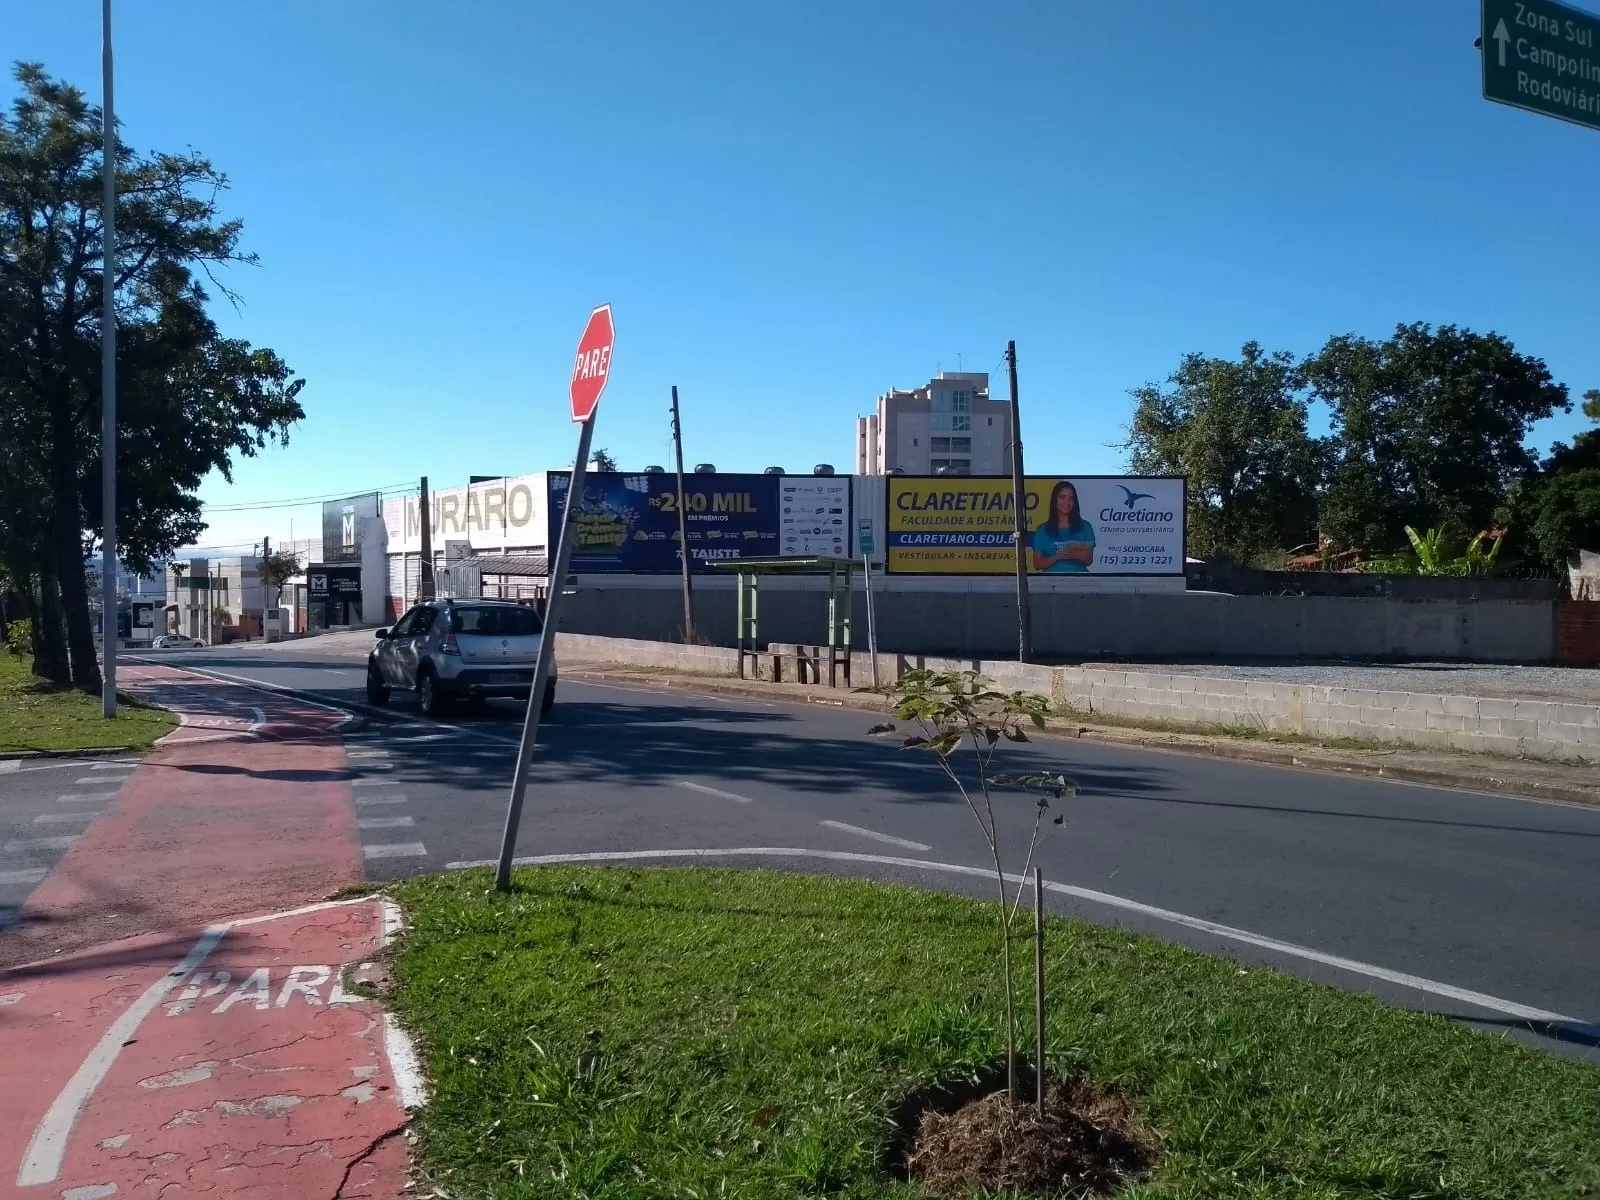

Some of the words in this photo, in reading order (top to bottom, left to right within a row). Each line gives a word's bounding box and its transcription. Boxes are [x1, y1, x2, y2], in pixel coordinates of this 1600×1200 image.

[1515, 2, 1559, 36] Zona
[1565, 20, 1592, 48] Sul
[1518, 70, 1600, 115] Rodoviári
[574, 345, 610, 381] PARE
[712, 492, 757, 512] MIL
[896, 491, 1040, 511] CLARETIANO
[407, 484, 533, 537] MURARO
[1100, 508, 1173, 521] Claretiano
[901, 516, 964, 525] FACULDADE
[966, 516, 974, 525] A
[690, 549, 741, 559] TAUSTE
[898, 552, 955, 560] VESTIBULAR
[1122, 545, 1165, 553] SOROCABA
[1099, 555, 1119, 565] (15)
[1121, 556, 1146, 564] 3233
[1150, 556, 1173, 564] 1221
